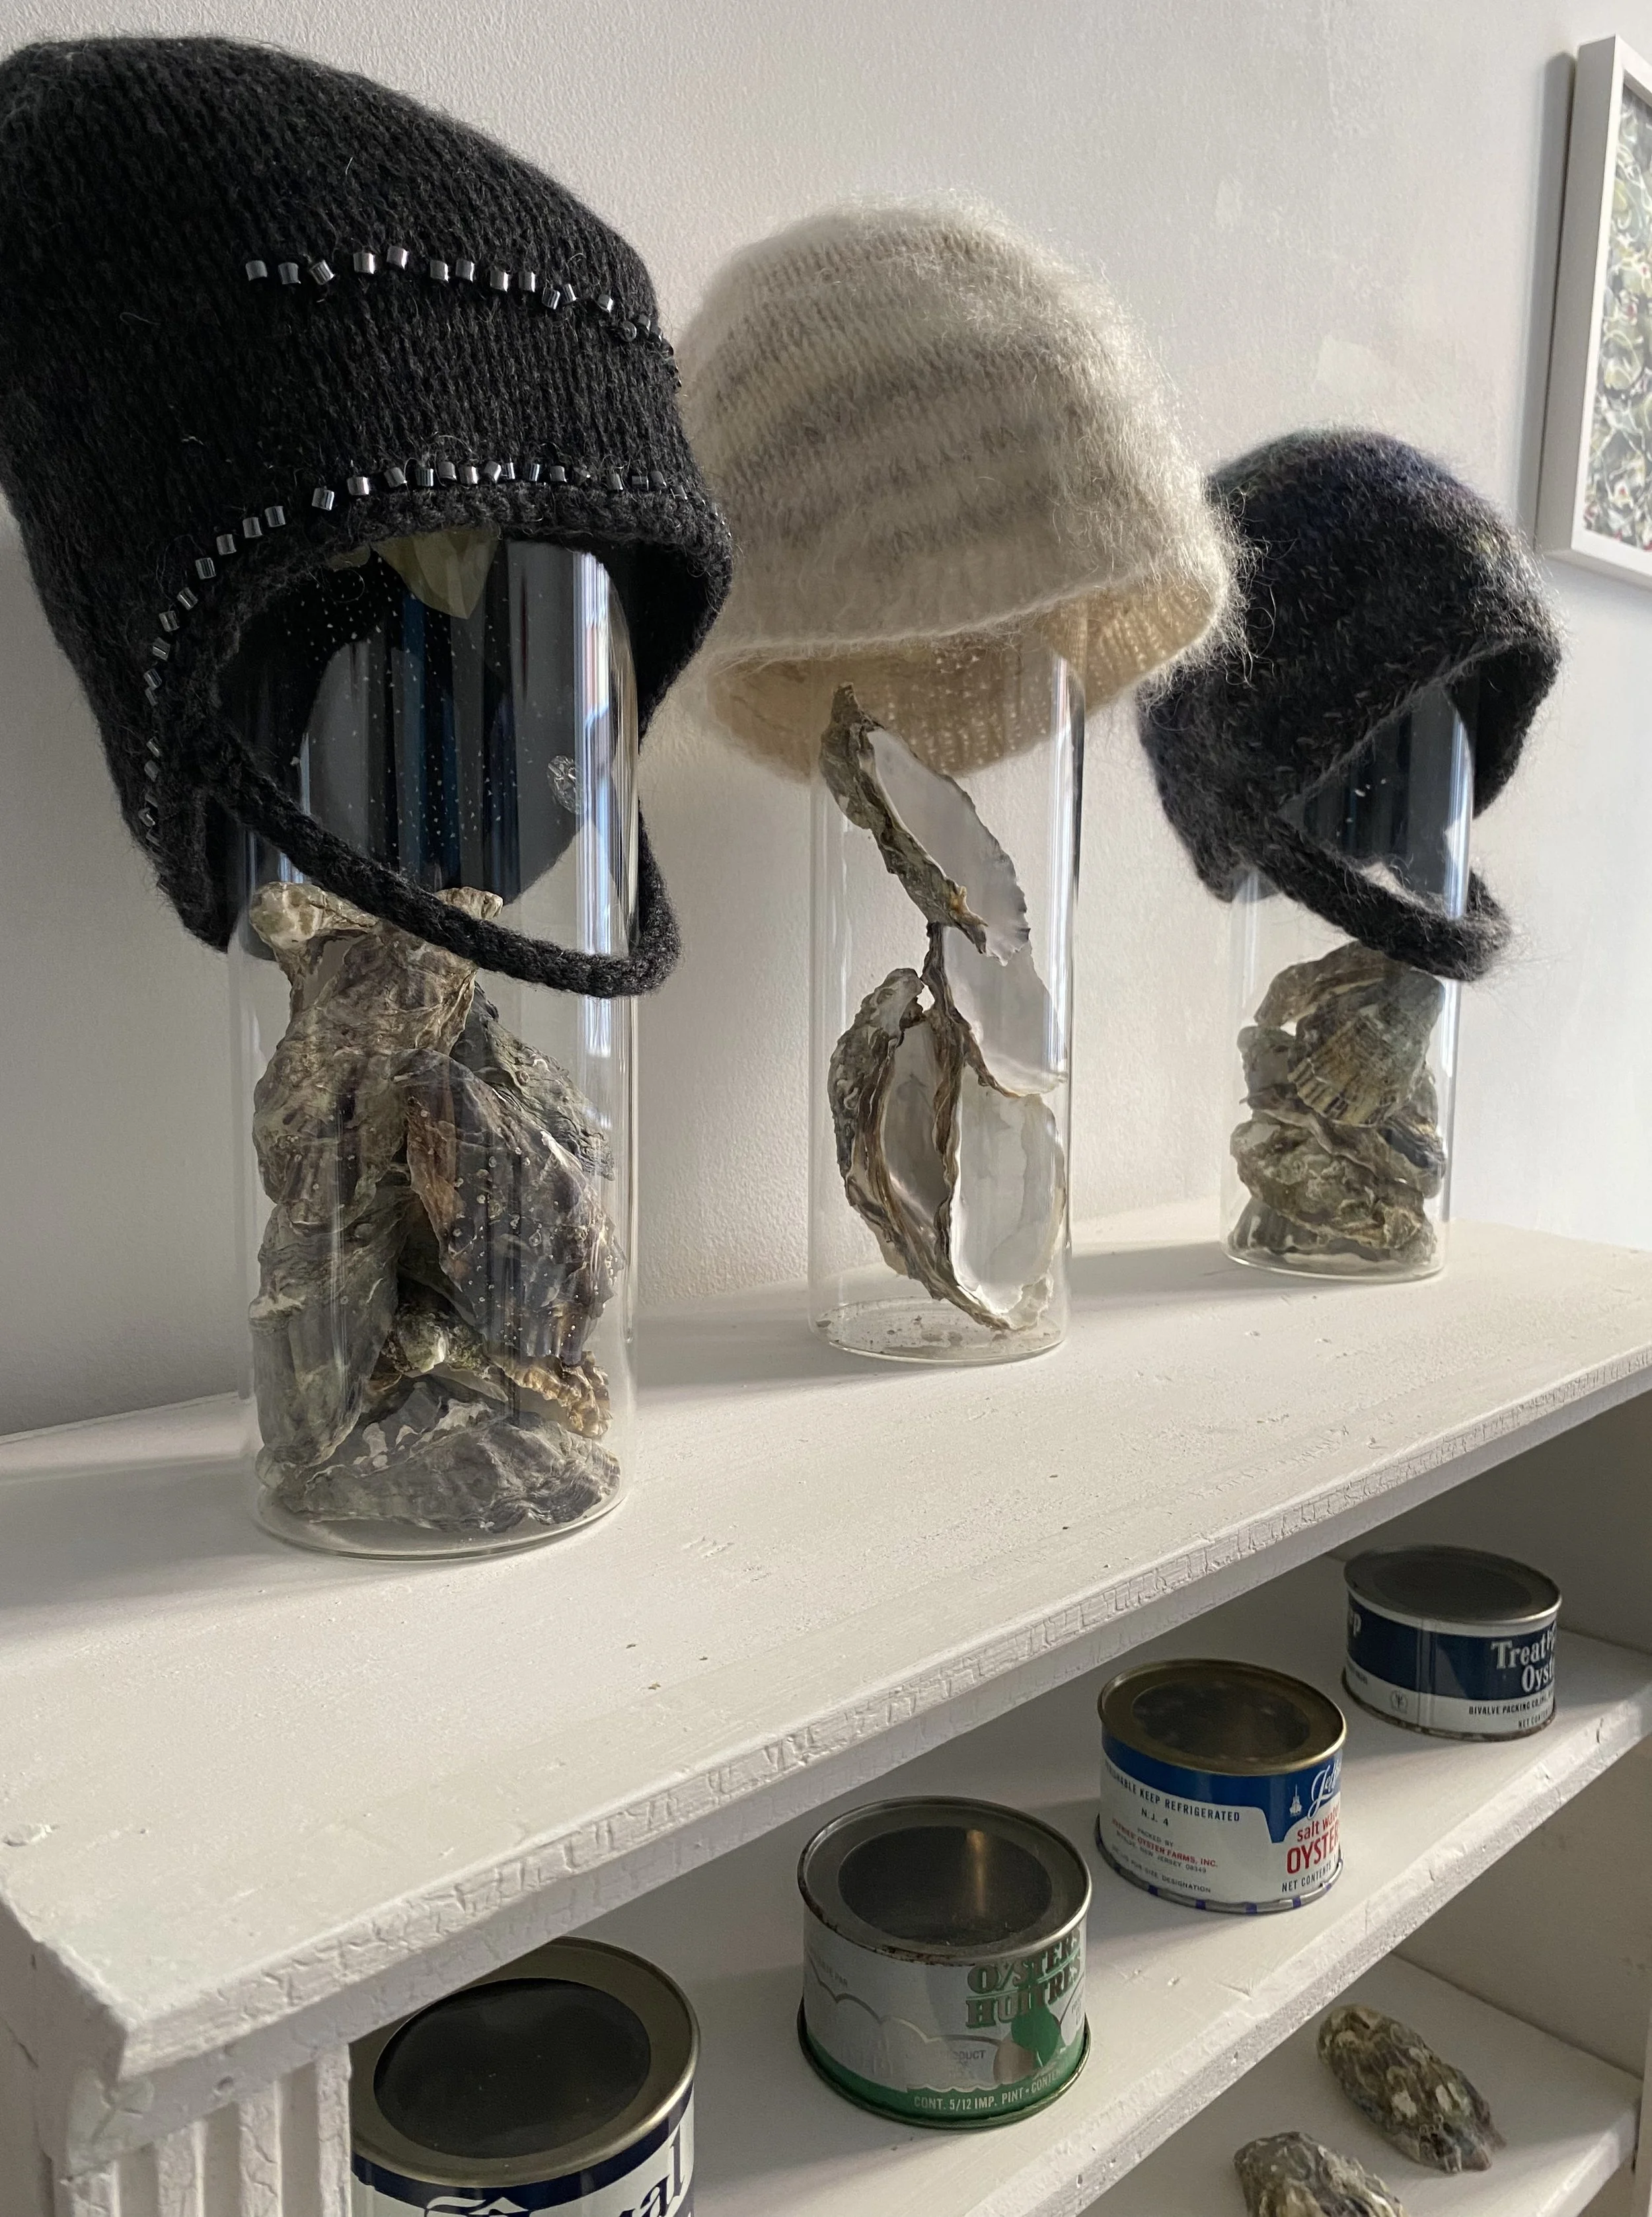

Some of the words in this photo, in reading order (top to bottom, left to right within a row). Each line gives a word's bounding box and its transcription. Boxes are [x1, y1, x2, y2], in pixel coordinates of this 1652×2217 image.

[1469, 1706, 1499, 1715] BIVALVE
[1503, 1702, 1530, 1714] PACKING
[1519, 1719, 1529, 1729] NET
[1140, 1789, 1160, 1805] KEEP
[1165, 1798, 1240, 1822] REFRIGERATED
[1163, 1818, 1169, 1826] 4
[1297, 1821, 1320, 1842] salt
[1137, 1827, 1162, 1843] PACKED
[1165, 1839, 1174, 1848] BY
[1137, 1836, 1166, 1856] OYSTER
[1167, 1848, 1197, 1864] FARMS,
[1201, 1858, 1218, 1867] INC.
[1157, 1856, 1182, 1868] JERSEY
[1185, 1864, 1207, 1873] 08349
[1162, 1875, 1211, 1893] DESIGNATION
[1282, 1878, 1297, 1893] NET
[1302, 1861, 1332, 1887] CONTENTS
[914, 2095, 947, 2110] CONT.
[950, 2097, 971, 2112] 5/12
[975, 2095, 997, 2110] IMP.
[1002, 2087, 1024, 2105] PINT
